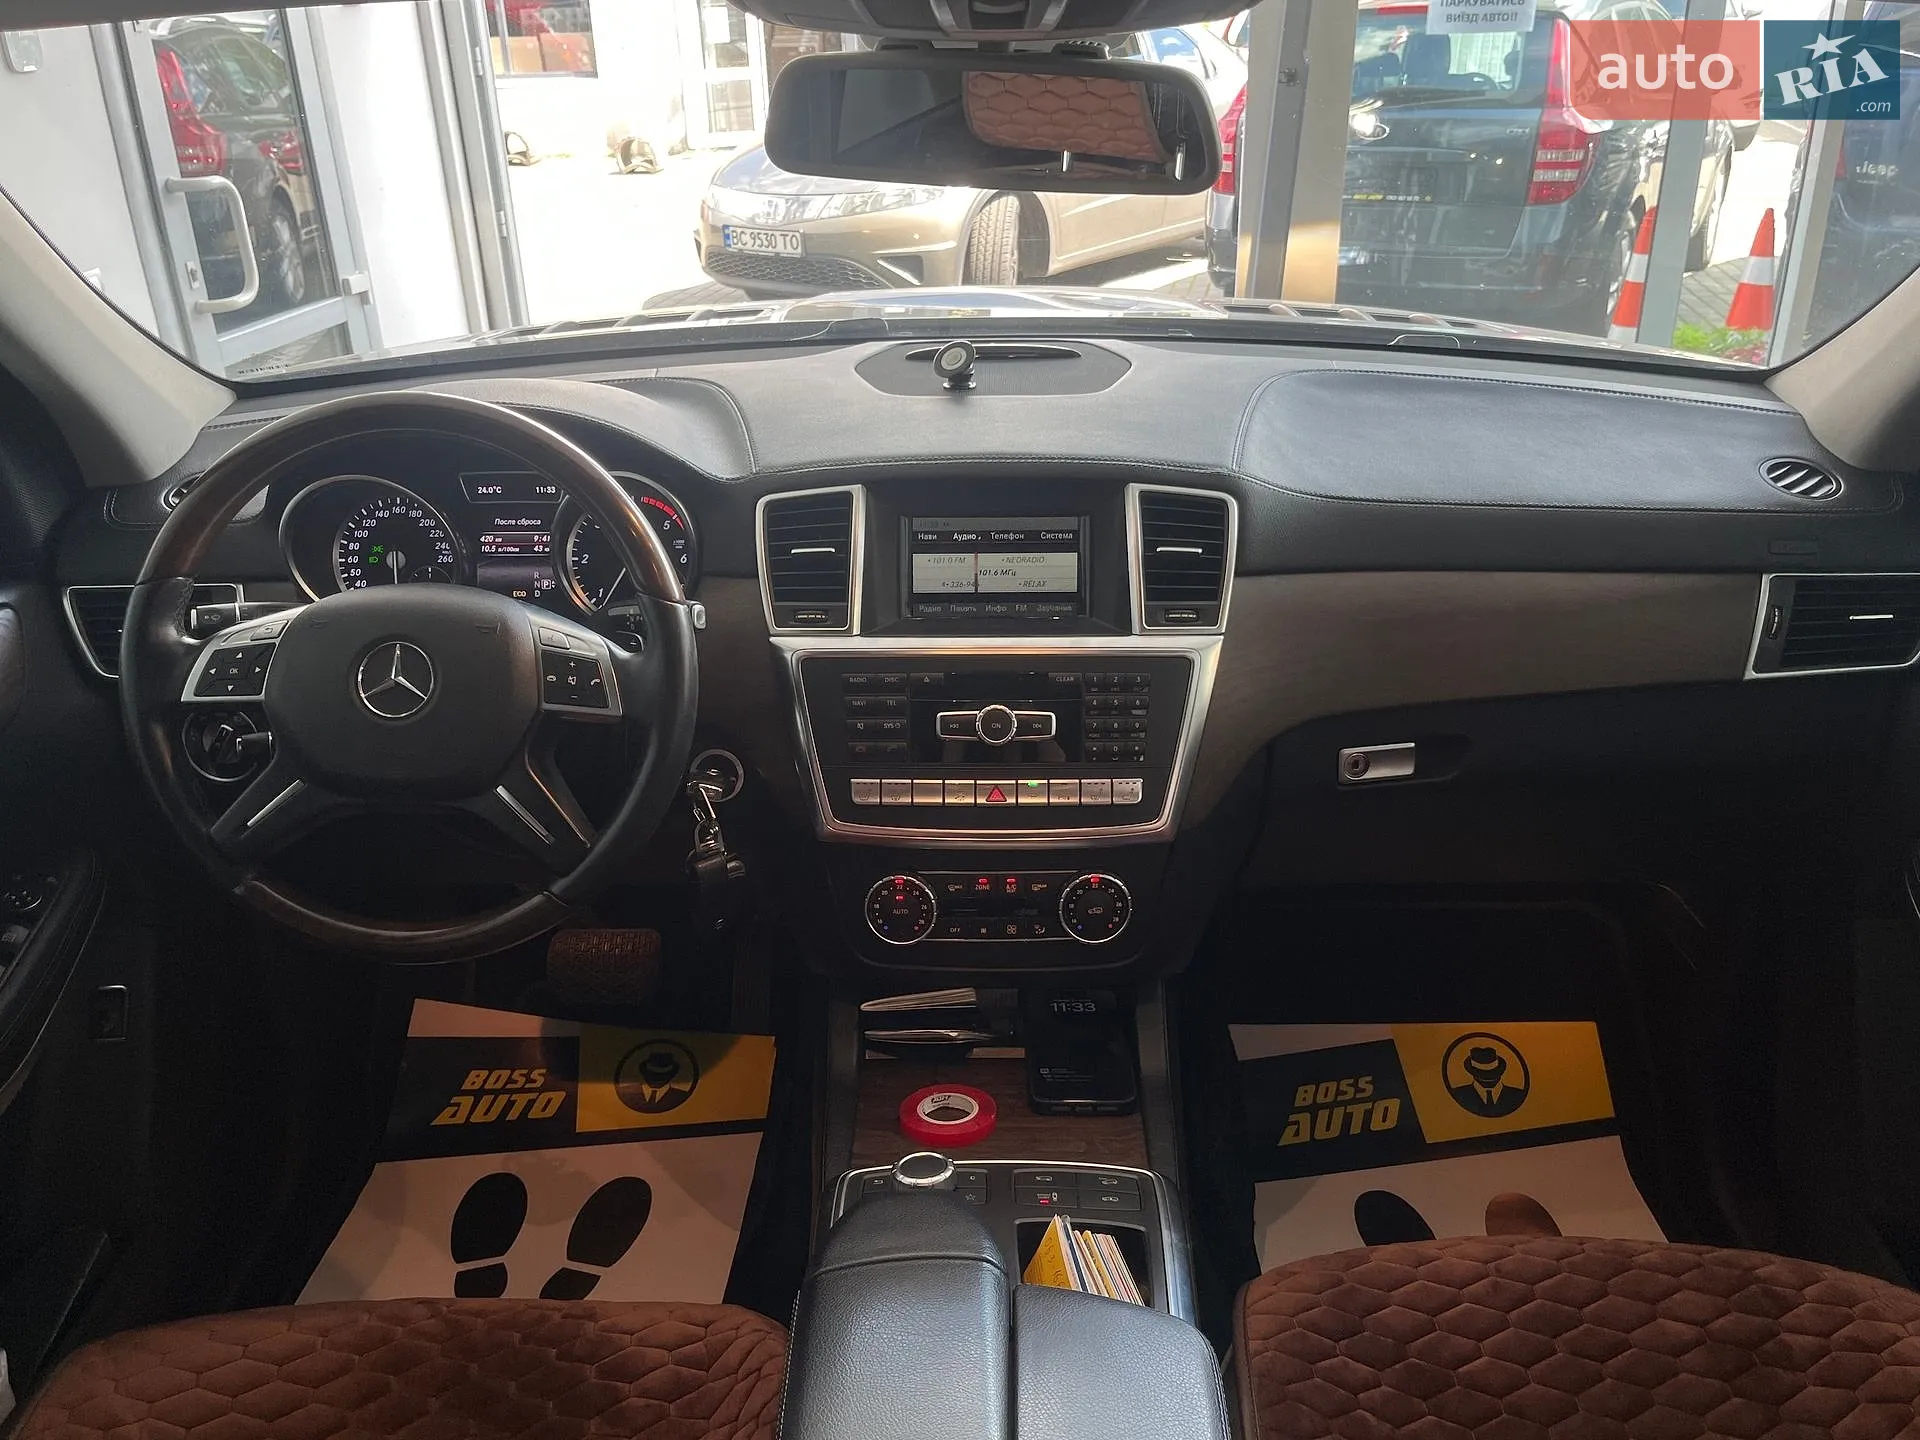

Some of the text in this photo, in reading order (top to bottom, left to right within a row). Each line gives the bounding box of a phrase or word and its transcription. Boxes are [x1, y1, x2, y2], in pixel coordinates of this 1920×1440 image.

[1446, 12, 1478, 23] ВИЇЗД
[731, 230, 800, 251] BC 9530 TO
[477, 485, 502, 494] 24.0°C
[535, 486, 556, 494] 11:33
[374, 510, 390, 518] 140
[392, 506, 406, 514] 160
[408, 510, 423, 518] 180
[362, 519, 377, 527] 120
[418, 519, 435, 527] 200
[495, 518, 541, 527] После сброса
[663, 520, 671, 530] 5
[354, 530, 369, 538] 100
[953, 533, 977, 541] Аудио
[990, 532, 1025, 541] Телефон
[1040, 532, 1073, 540] Система
[480, 535, 494, 543] 420
[348, 542, 360, 550] 80
[481, 545, 496, 553] 10.5
[437, 555, 454, 563] 260
[581, 554, 589, 564] 2
[680, 554, 688, 564] 6
[349, 568, 361, 576] 50
[979, 569, 1017, 577] 101.6 МГц
[355, 580, 367, 588] 40
[598, 588, 604, 598] 1
[919, 605, 942, 613] Радио
[985, 605, 1007, 613] Инфо
[229, 667, 239, 675] OK
[1049, 1001, 1097, 1013] 11:33
[460, 1069, 549, 1090] BOSS
[1294, 1075, 1375, 1108] BOSS
[430, 1091, 567, 1126] AUTO
[1277, 1097, 1401, 1147] AUTO
